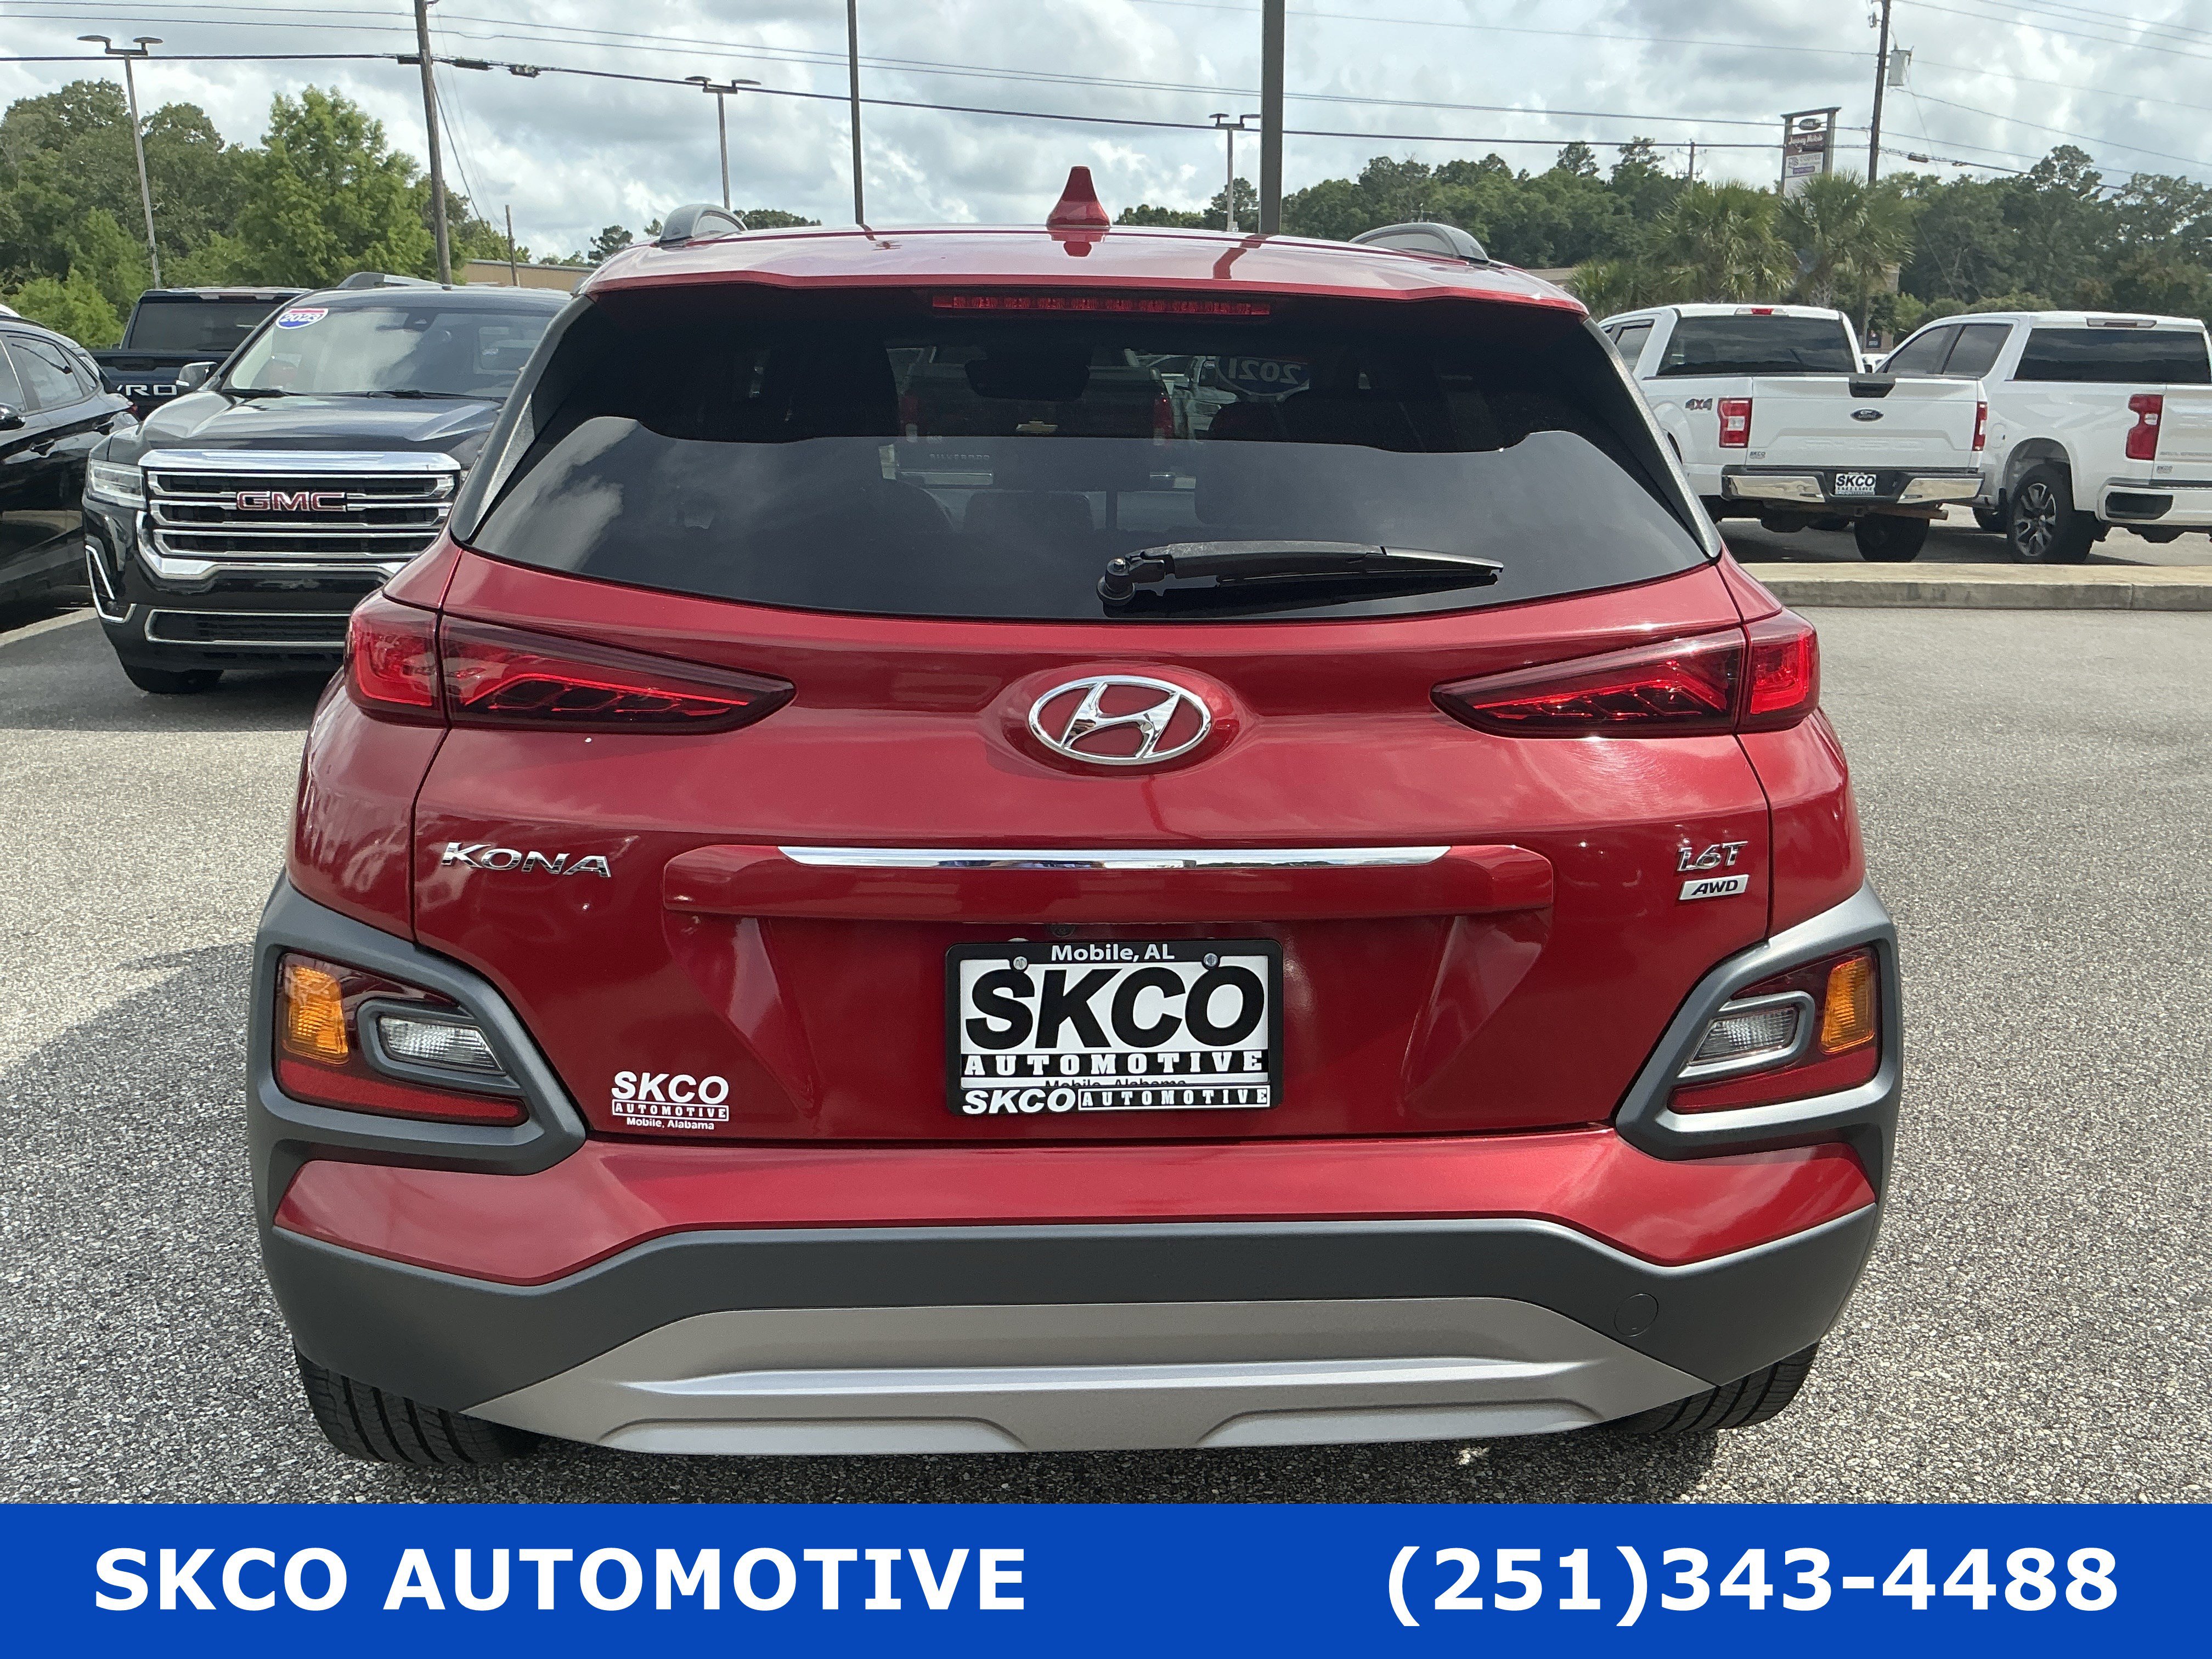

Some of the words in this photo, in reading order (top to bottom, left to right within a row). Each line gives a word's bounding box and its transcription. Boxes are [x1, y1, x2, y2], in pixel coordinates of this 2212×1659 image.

[280, 313, 320, 322] 2023
[1836, 475, 1875, 487] SKCO
[236, 491, 347, 512] GMC
[441, 842, 612, 878] KONA
[1691, 879, 1739, 896] AWD
[1051, 944, 1140, 963] Mobile,
[1144, 944, 1175, 960] AL
[965, 966, 1265, 1050] SKCO
[964, 1052, 1262, 1076] AUTOMOTIVE
[611, 1071, 729, 1105] SKCO
[615, 1103, 726, 1118] AUTOMOTIVE
[962, 1088, 1076, 1115] SKCO
[1082, 1088, 1267, 1107] AUTOMOTIVE
[627, 1117, 665, 1128] Mobile,
[667, 1119, 714, 1130] Alabama
